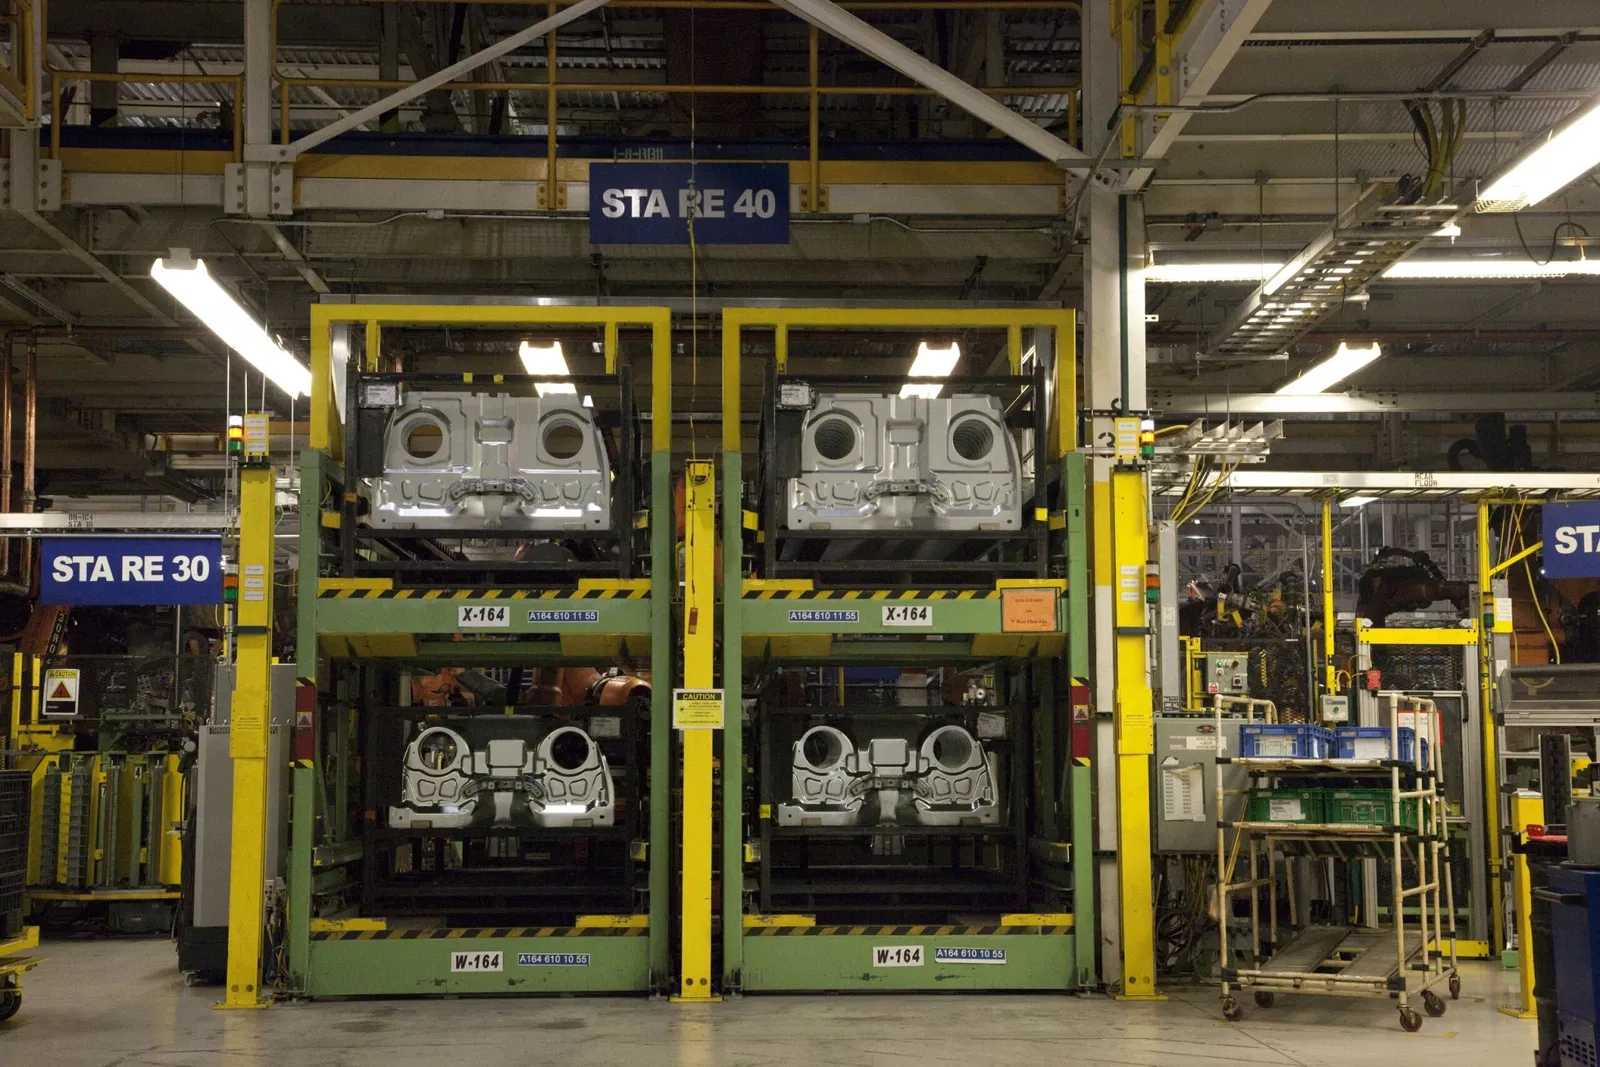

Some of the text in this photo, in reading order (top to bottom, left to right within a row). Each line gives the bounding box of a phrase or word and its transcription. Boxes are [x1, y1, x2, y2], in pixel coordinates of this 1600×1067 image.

[601, 188, 776, 218] STA RE 40
[1554, 525, 1600, 555] ST
[52, 555, 210, 582] STA RE 30
[462, 607, 505, 622] X-164
[529, 611, 596, 620] A164 610 11 55
[790, 611, 857, 620] A164 610 11 55
[886, 607, 927, 621] X-164
[519, 954, 587, 964] A164 610 10 55
[877, 948, 920, 964] W-164
[936, 949, 1003, 958] A164 610 10 55
[455, 954, 499, 969] W-164
